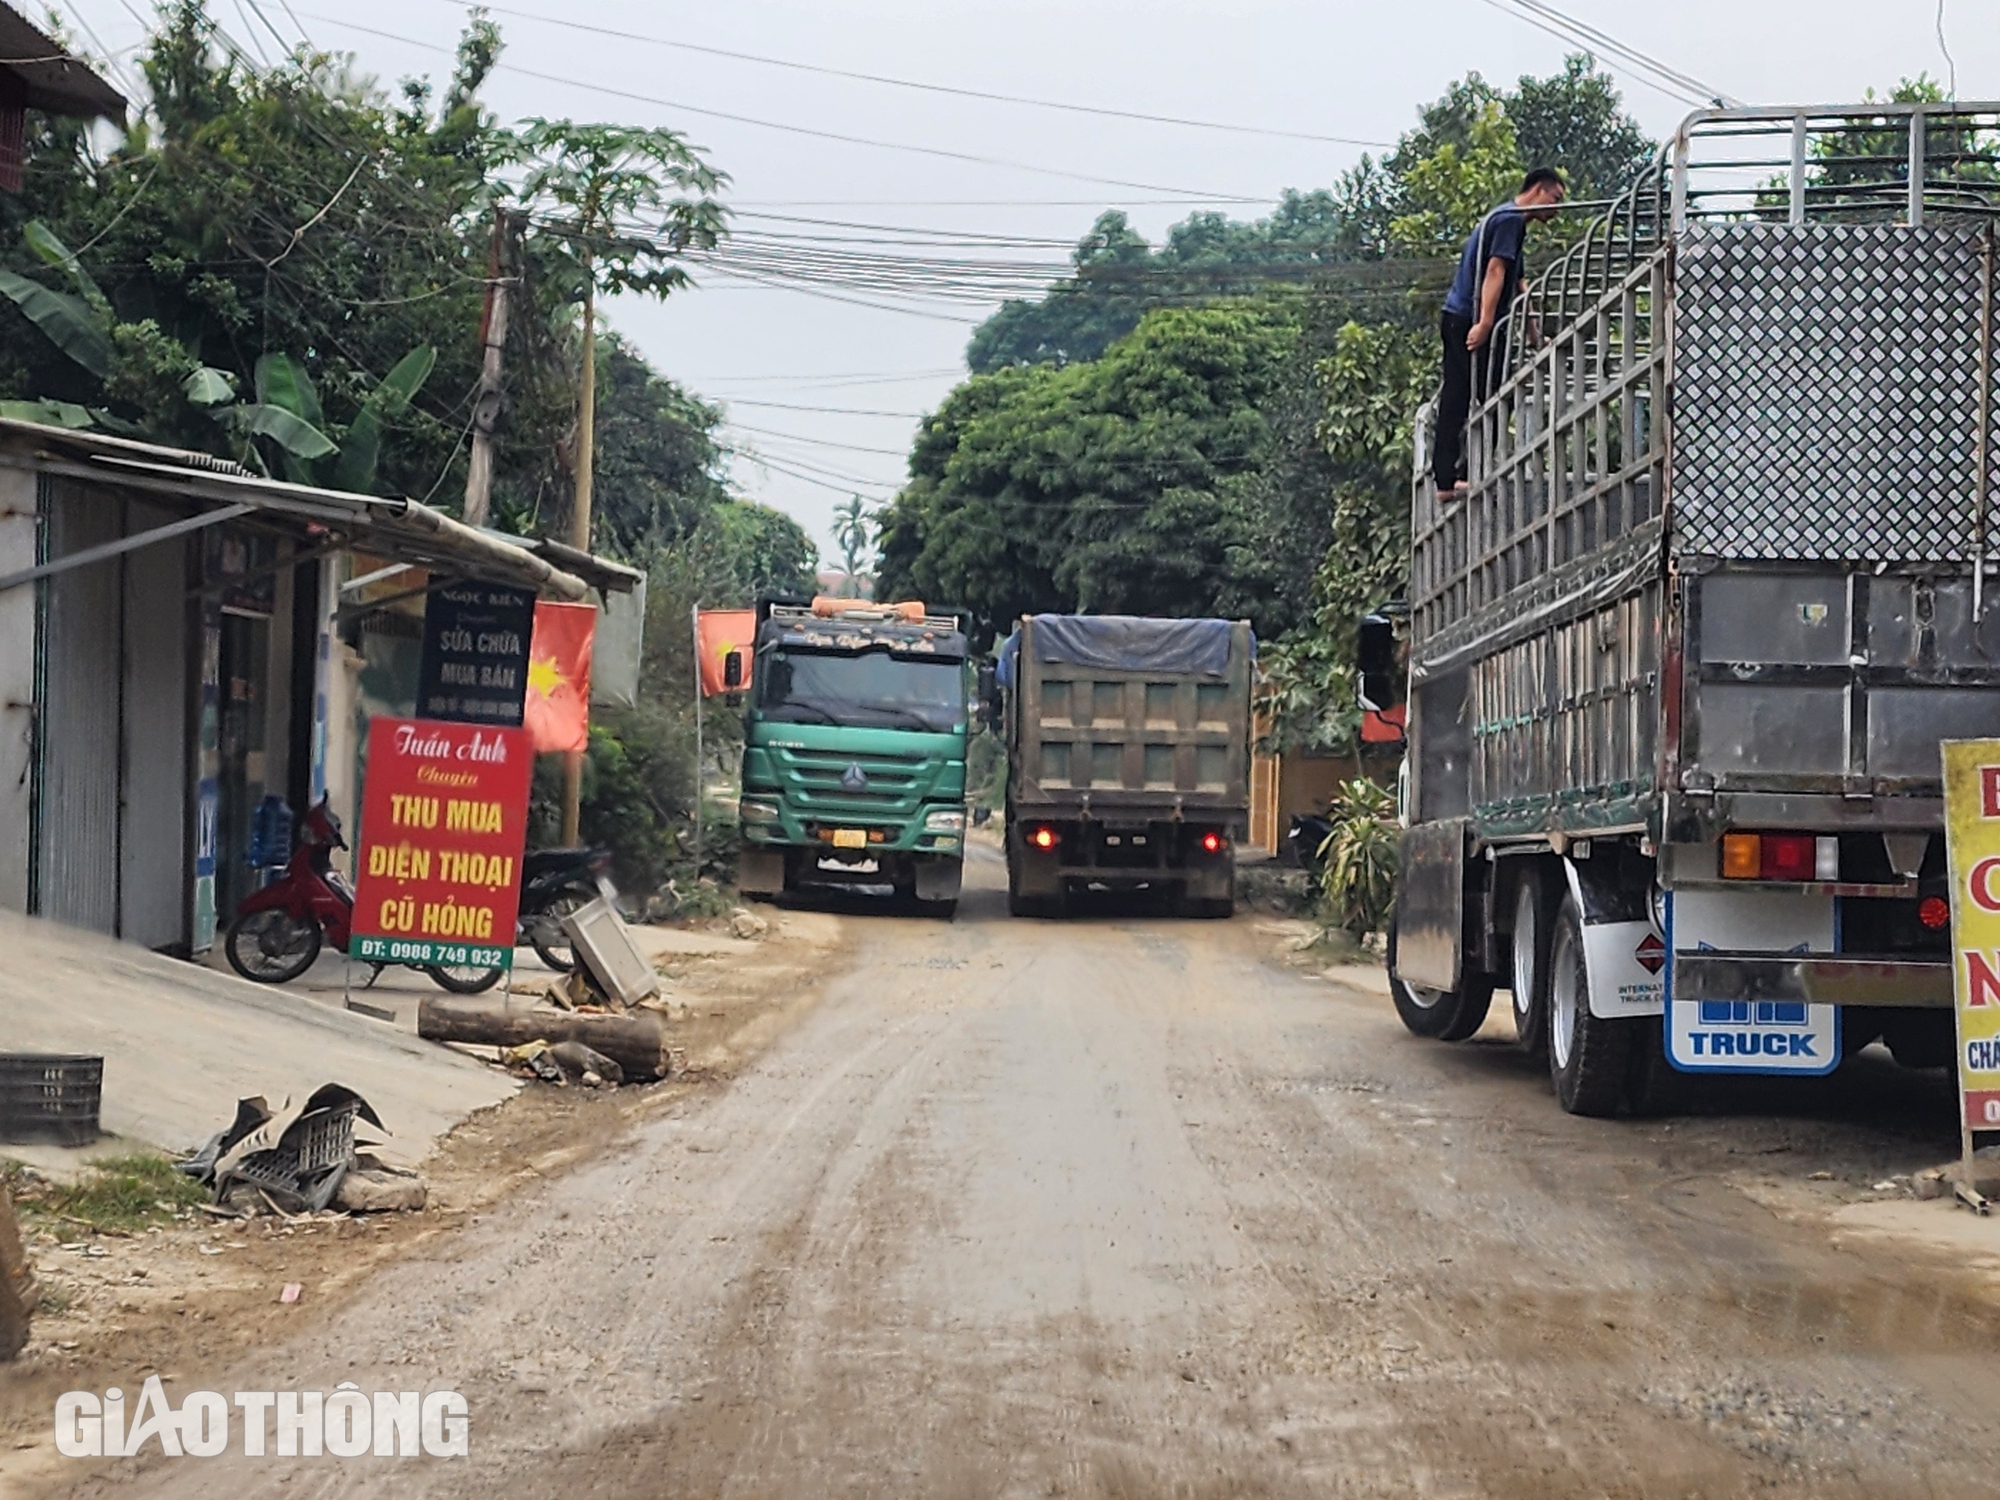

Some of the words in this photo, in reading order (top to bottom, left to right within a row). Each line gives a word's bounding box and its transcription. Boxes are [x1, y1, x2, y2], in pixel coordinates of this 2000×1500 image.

[456, 731, 507, 763] Anh
[390, 794, 439, 829] THU
[446, 799, 502, 833] MUA
[369, 839, 431, 885] ĐIỆN
[439, 852, 513, 892] THOẠI
[380, 895, 415, 932] CŨ
[422, 895, 493, 938] HỎNG
[361, 940, 386, 957] ĐT:
[391, 943, 431, 960] 0988
[436, 946, 466, 962] 749
[471, 949, 501, 965] 032
[1688, 1033, 1818, 1056] TRUCK
